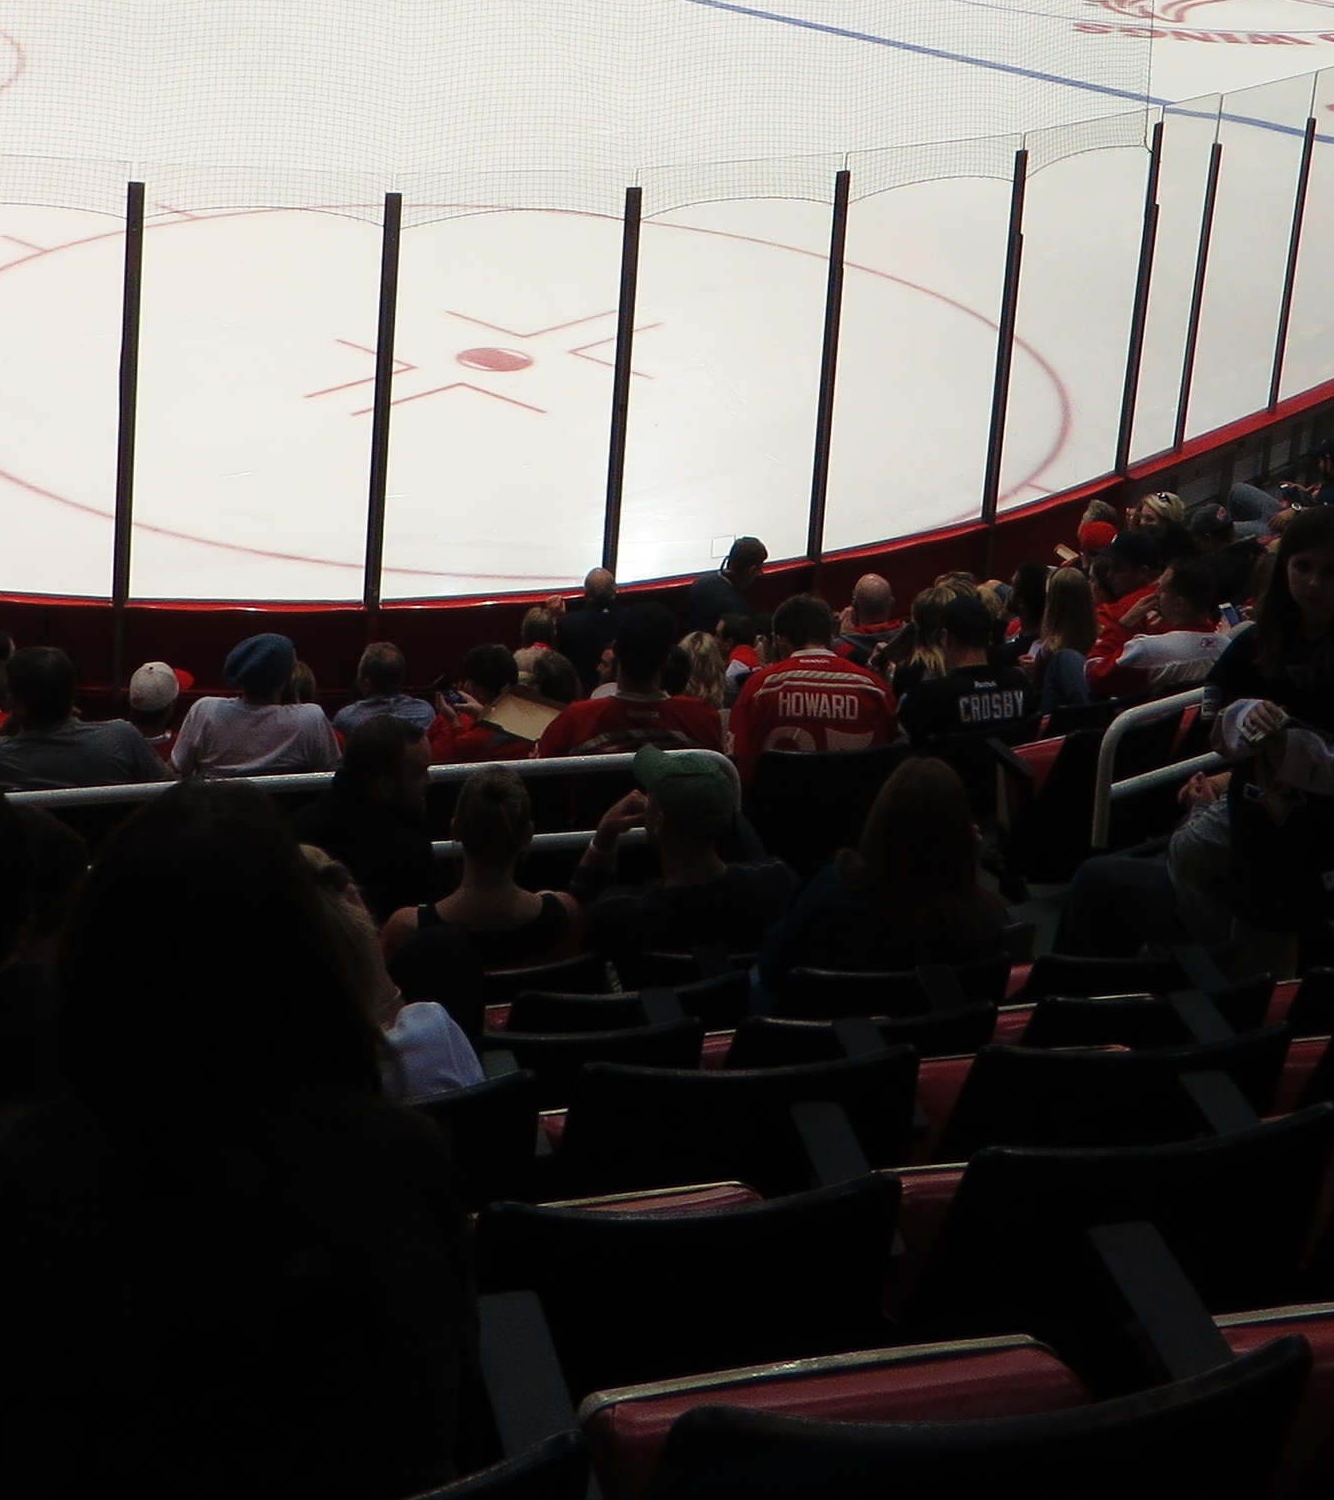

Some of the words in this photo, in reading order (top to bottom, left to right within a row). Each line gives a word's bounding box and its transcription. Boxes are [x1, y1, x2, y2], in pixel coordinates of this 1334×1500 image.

[1073, 23, 1309, 46] WINGS
[778, 691, 859, 721] HOWARD
[958, 690, 1024, 724] CROSBY
